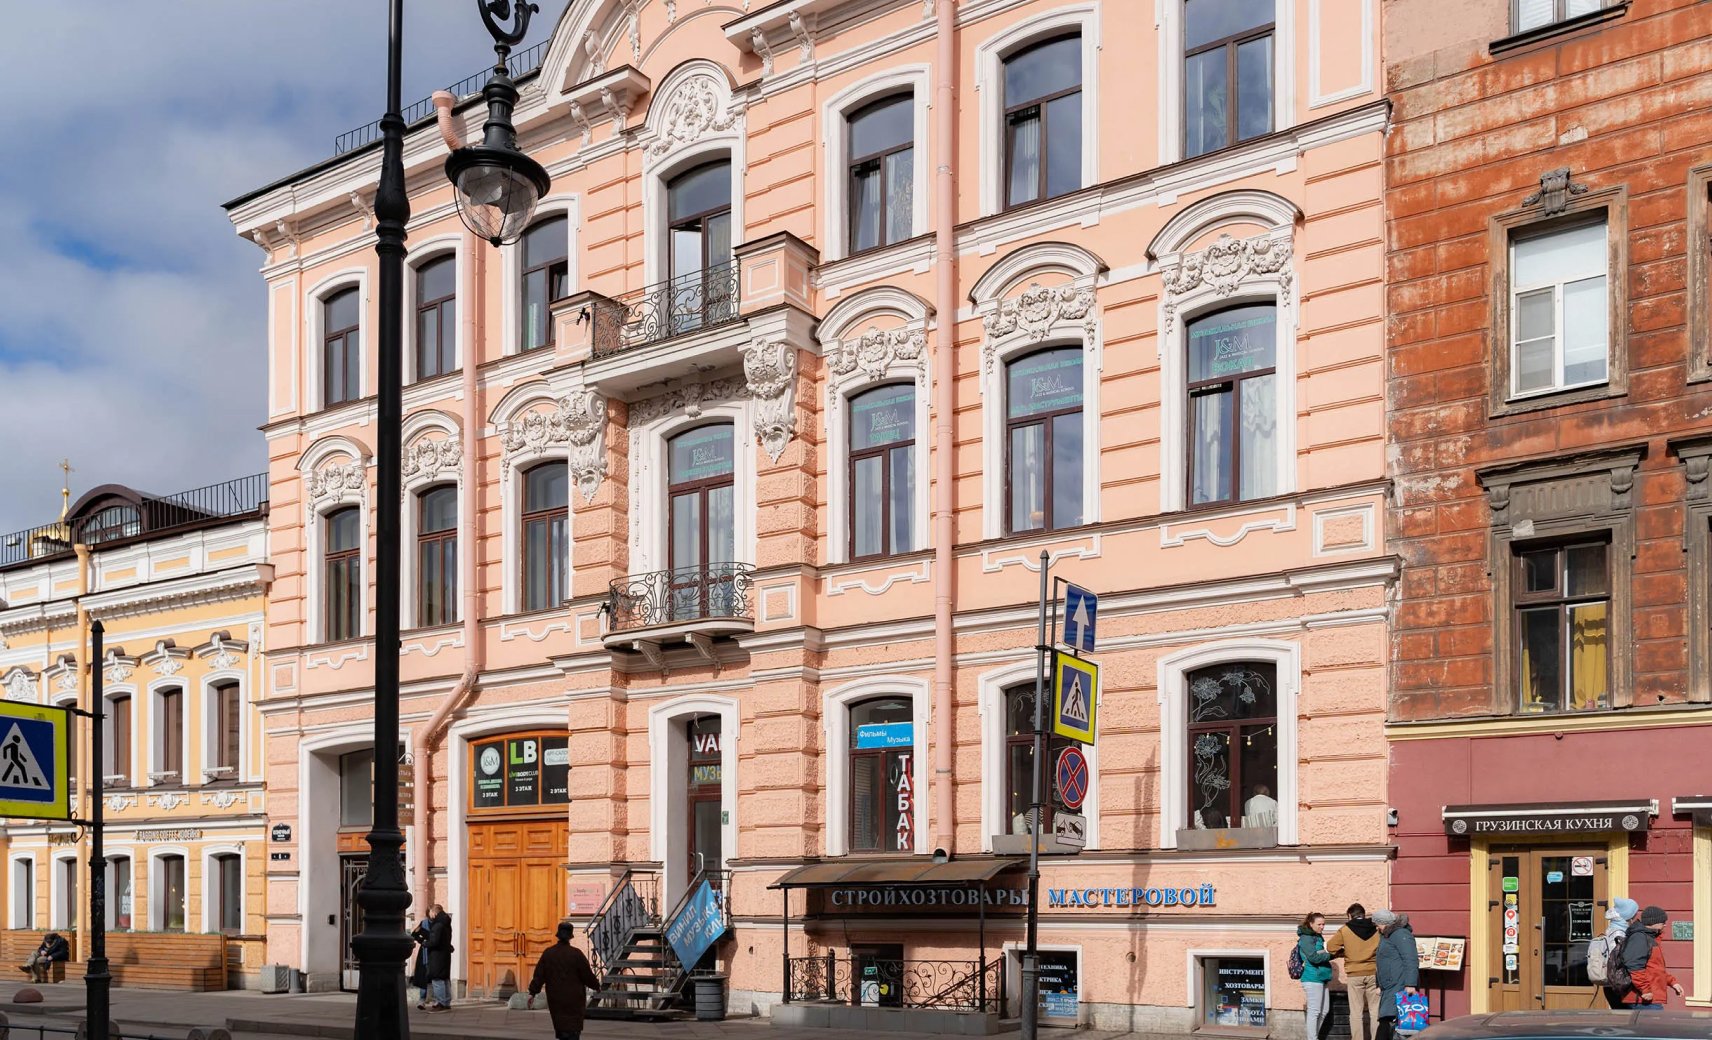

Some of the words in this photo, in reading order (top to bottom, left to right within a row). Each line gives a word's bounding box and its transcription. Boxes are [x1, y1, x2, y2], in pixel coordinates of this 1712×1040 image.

[1212, 356, 1254, 374] ВОКАЛ
[859, 730, 887, 738] Фильмы
[887, 736, 911, 744] Музыка
[510, 740, 537, 765] LB
[896, 755, 911, 850] ТАБАК
[1475, 819, 1562, 831] ГРУЗИНСКАЯ
[1565, 818, 1613, 830] КУХНЯ
[831, 887, 1028, 906] СТРОЙХОЗТОВАРЫ
[1048, 883, 1216, 905] МАСТЕРОВОЙ
[668, 905, 697, 945] ВИНИЛ
[683, 901, 717, 947] МУЗЫКА
